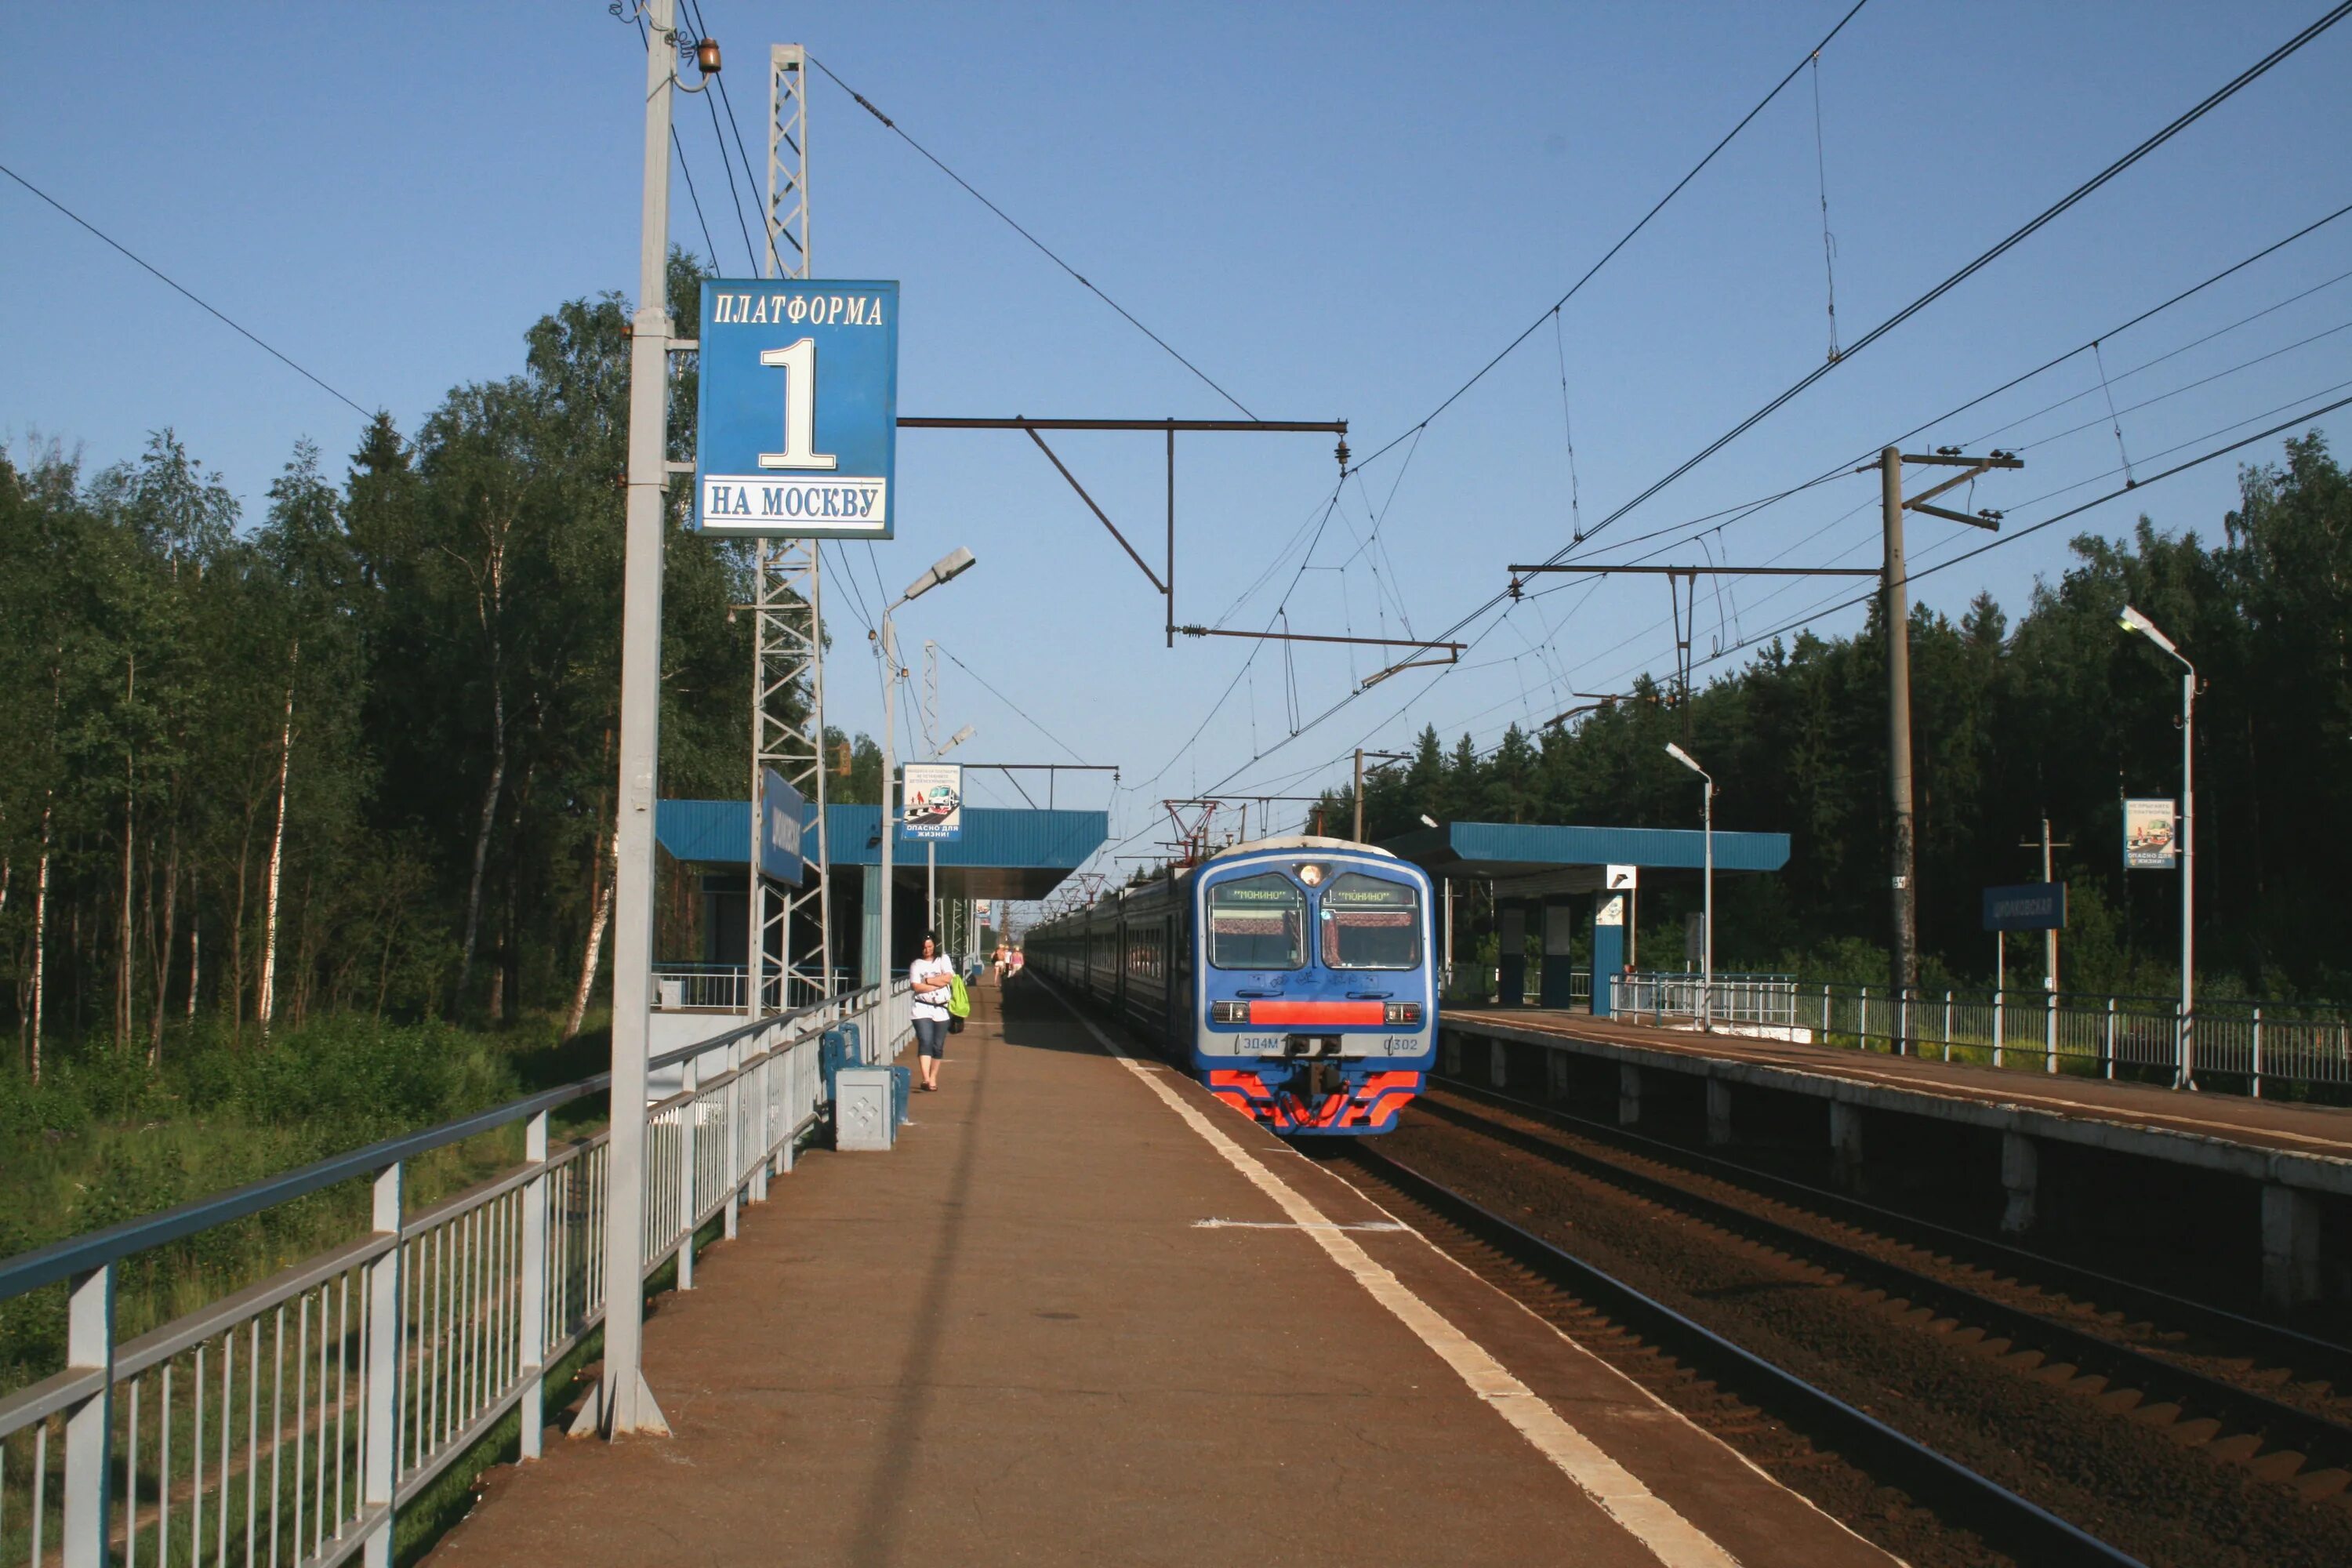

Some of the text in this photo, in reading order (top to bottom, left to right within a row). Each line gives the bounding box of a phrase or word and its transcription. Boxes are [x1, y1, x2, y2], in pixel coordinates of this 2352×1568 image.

[714, 295, 883, 325] ПЛАТФОРМА
[759, 338, 837, 469] 1
[711, 486, 879, 517] НА МОСКВУ
[1243, 1037, 1279, 1049] ЭД4М
